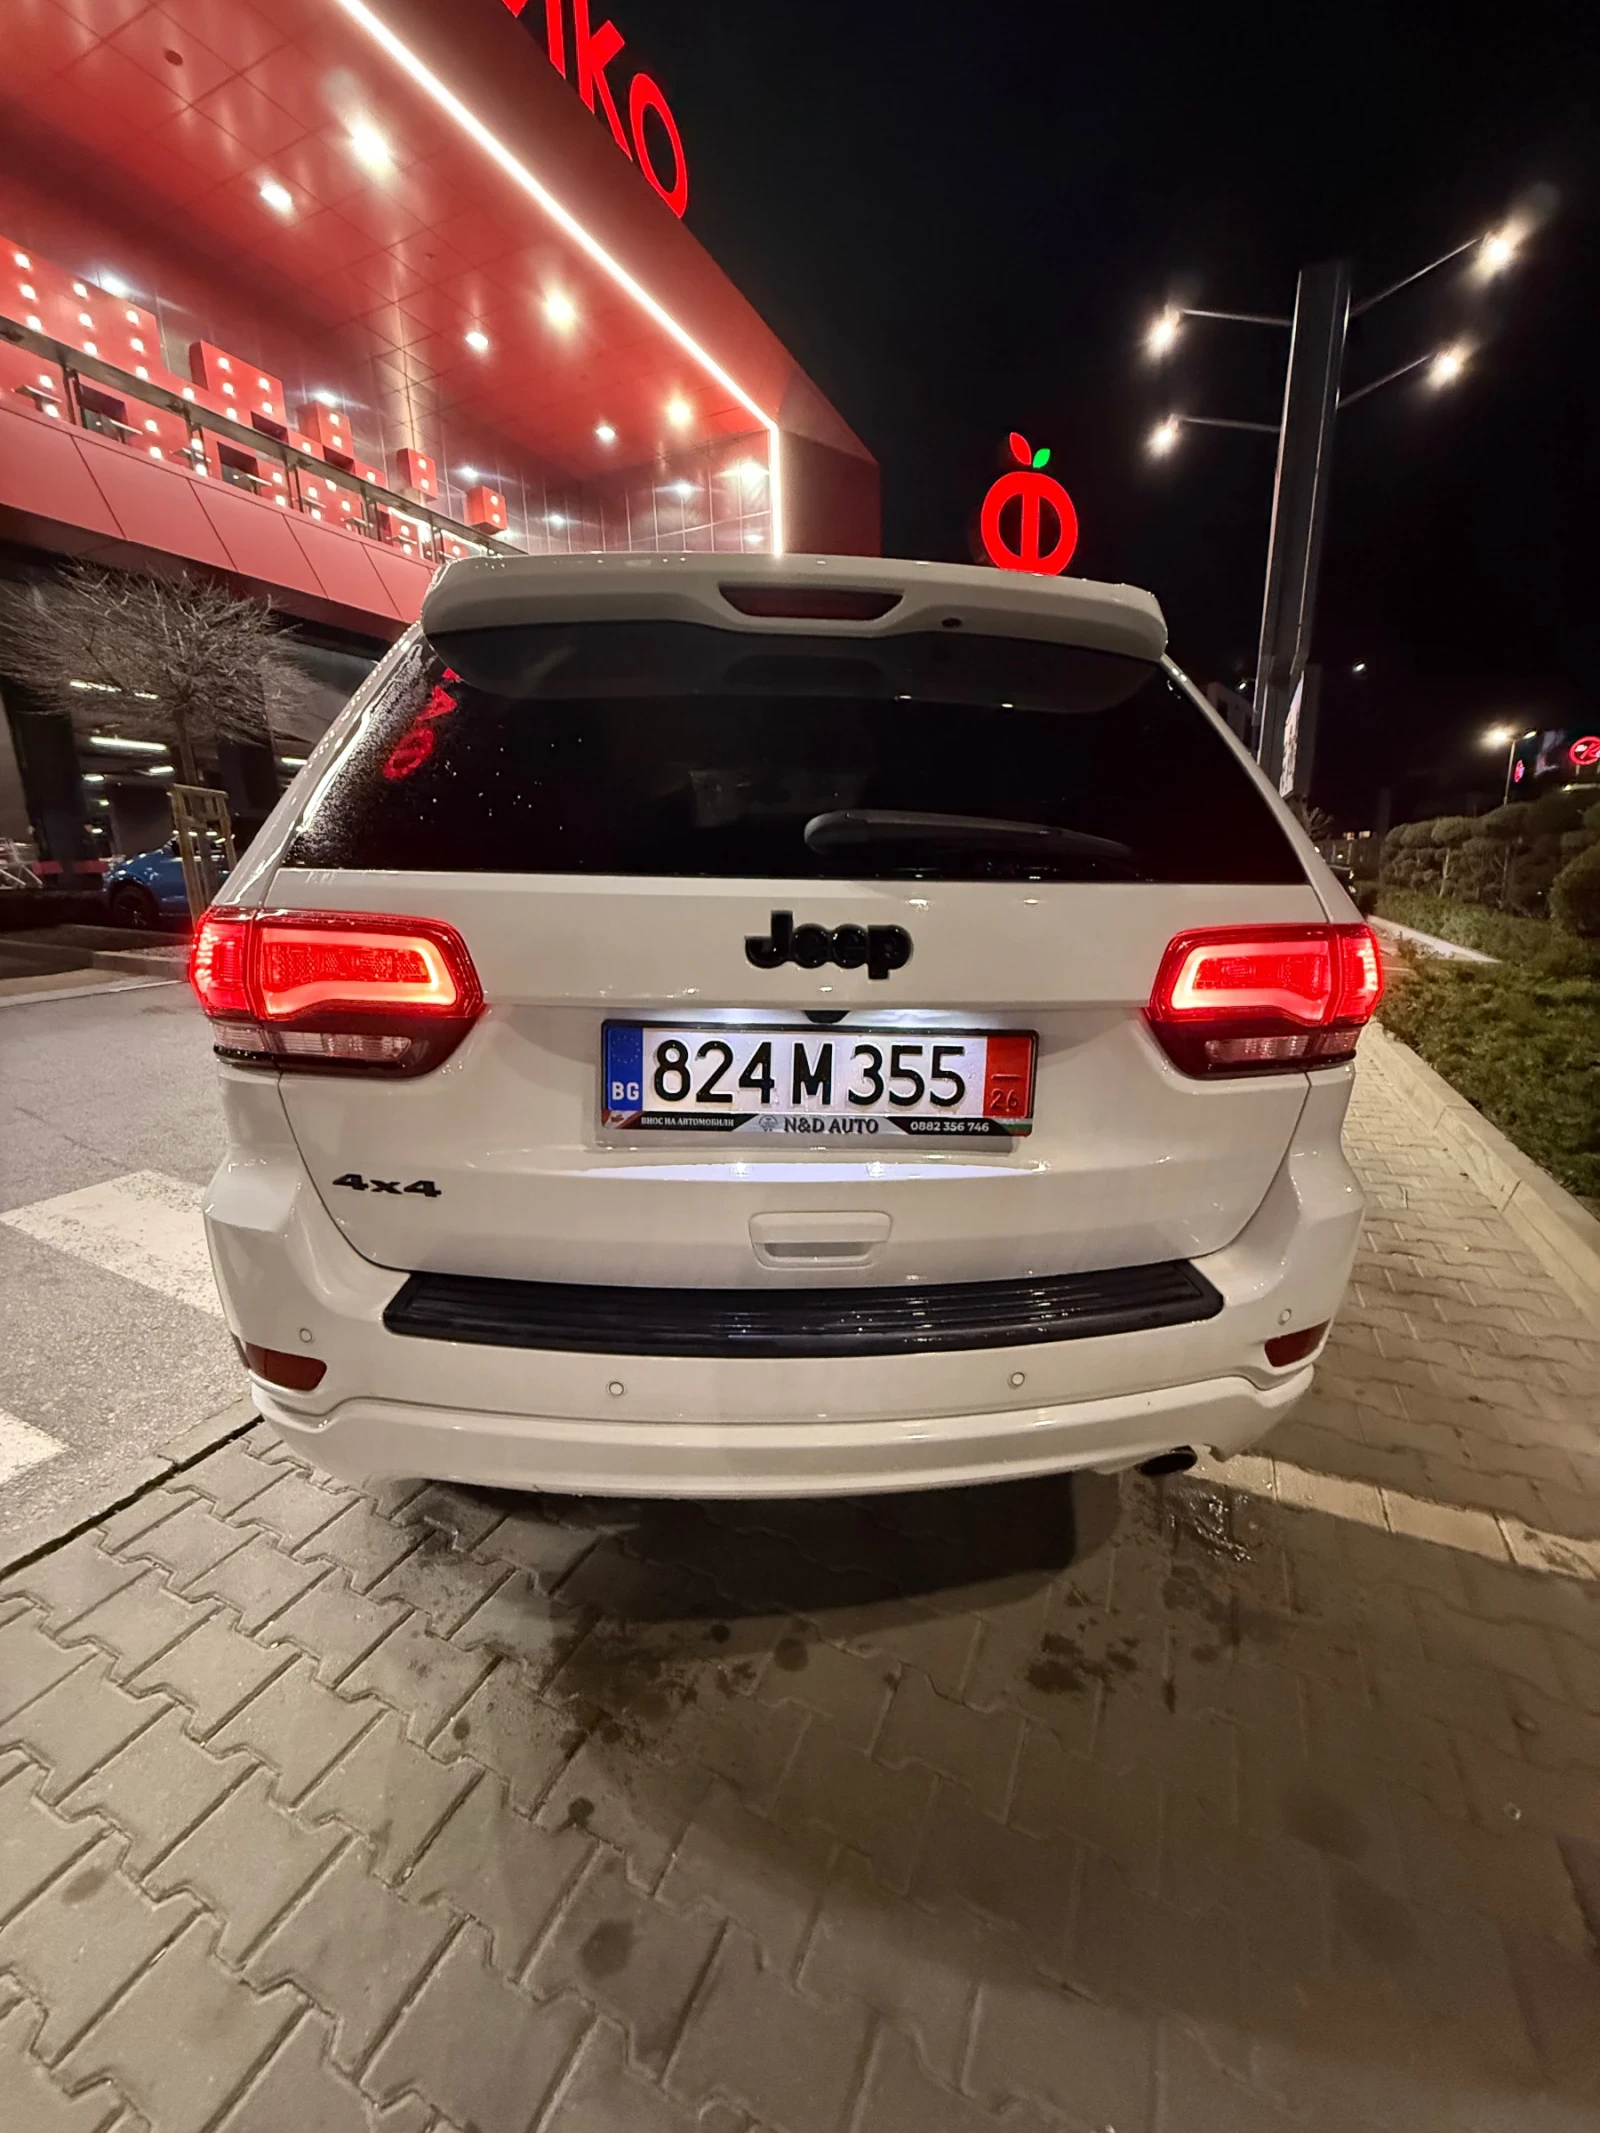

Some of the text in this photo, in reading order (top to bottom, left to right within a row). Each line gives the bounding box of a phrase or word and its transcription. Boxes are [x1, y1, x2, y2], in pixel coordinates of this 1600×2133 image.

[744, 910, 914, 980] Jeep
[654, 1039, 966, 1107] 824 M 355
[611, 1081, 640, 1101] BG
[990, 1088, 1018, 1110] 26
[641, 1116, 735, 1127] ВНОС НА АВТОМОБИЛИ
[783, 1116, 879, 1134] N&D AUTO
[910, 1121, 990, 1133] 0882 356 746
[332, 1173, 442, 1198] 4x4
